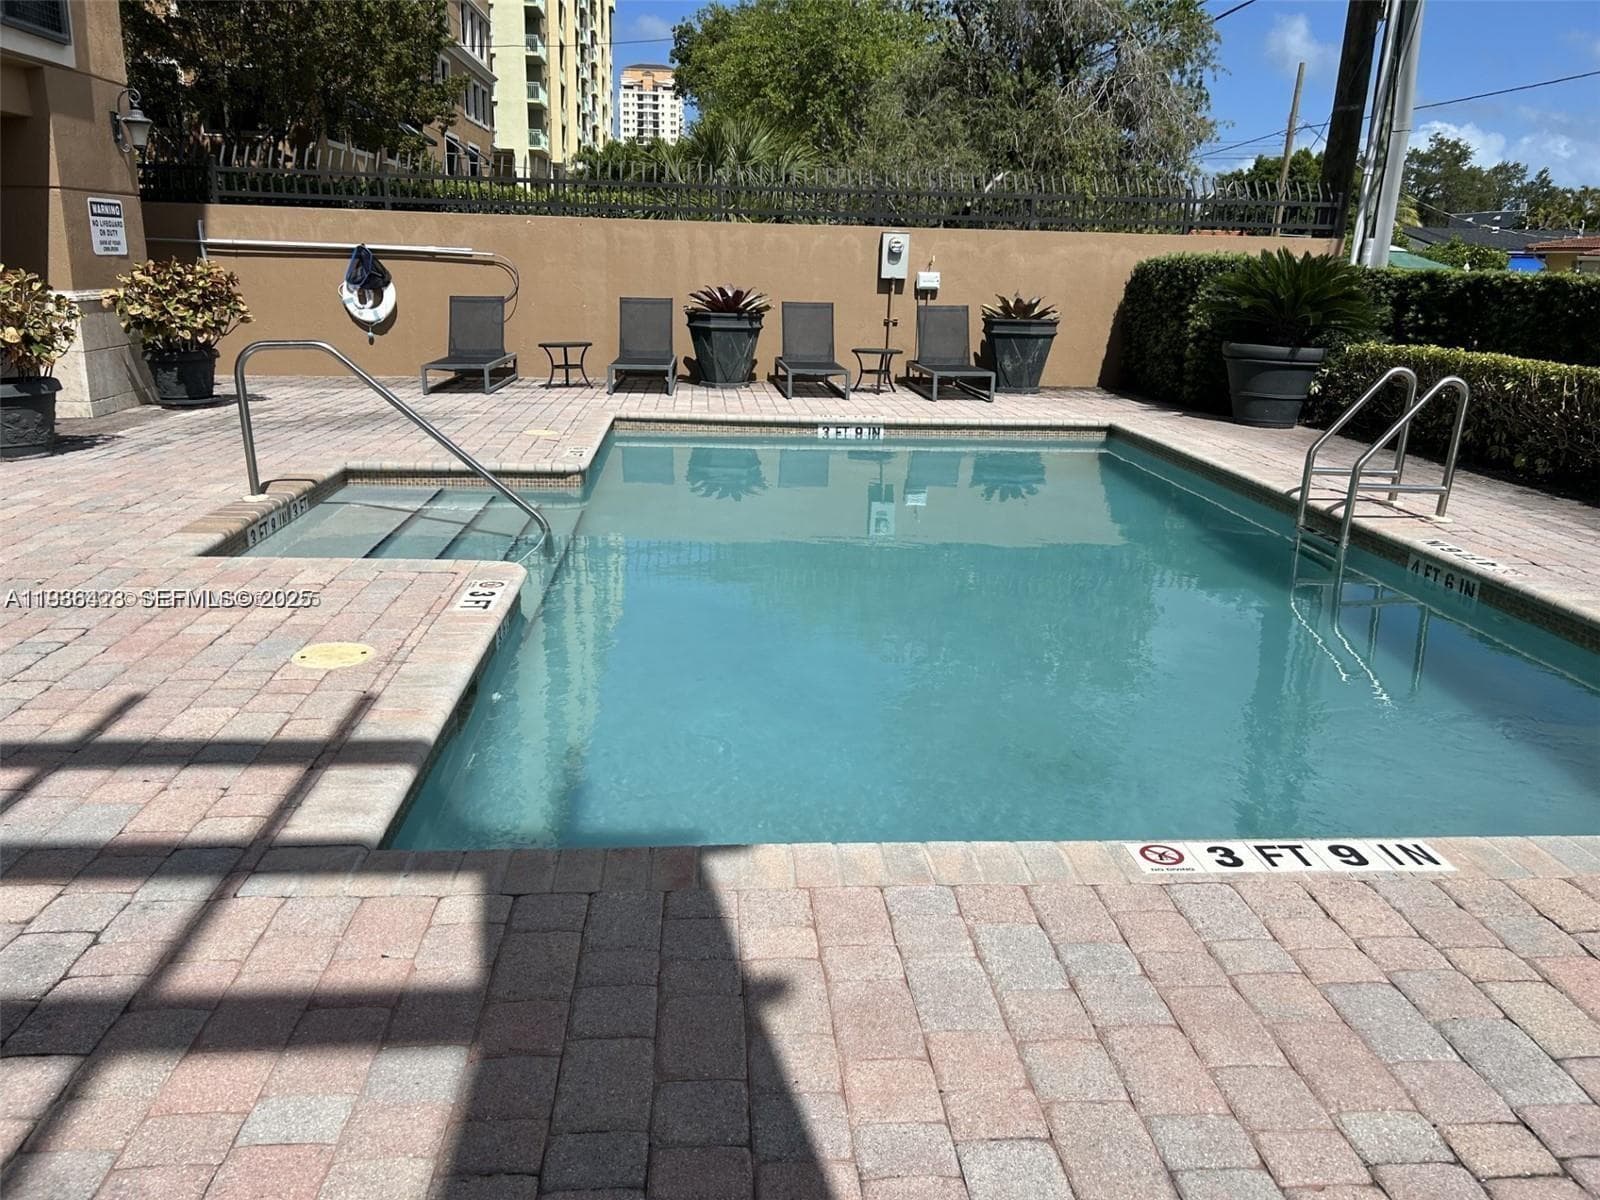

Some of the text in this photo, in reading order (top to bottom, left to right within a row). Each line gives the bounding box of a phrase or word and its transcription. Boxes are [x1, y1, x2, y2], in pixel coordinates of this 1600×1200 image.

[91, 203, 121, 216] WARNING
[92, 219, 99, 227] NO
[1423, 564, 1441, 582] FT
[1445, 573, 1455, 589] 6
[1460, 578, 1476, 598] IN
[459, 600, 492, 610] FT
[1206, 843, 1442, 868] 3 FT 9 IN
